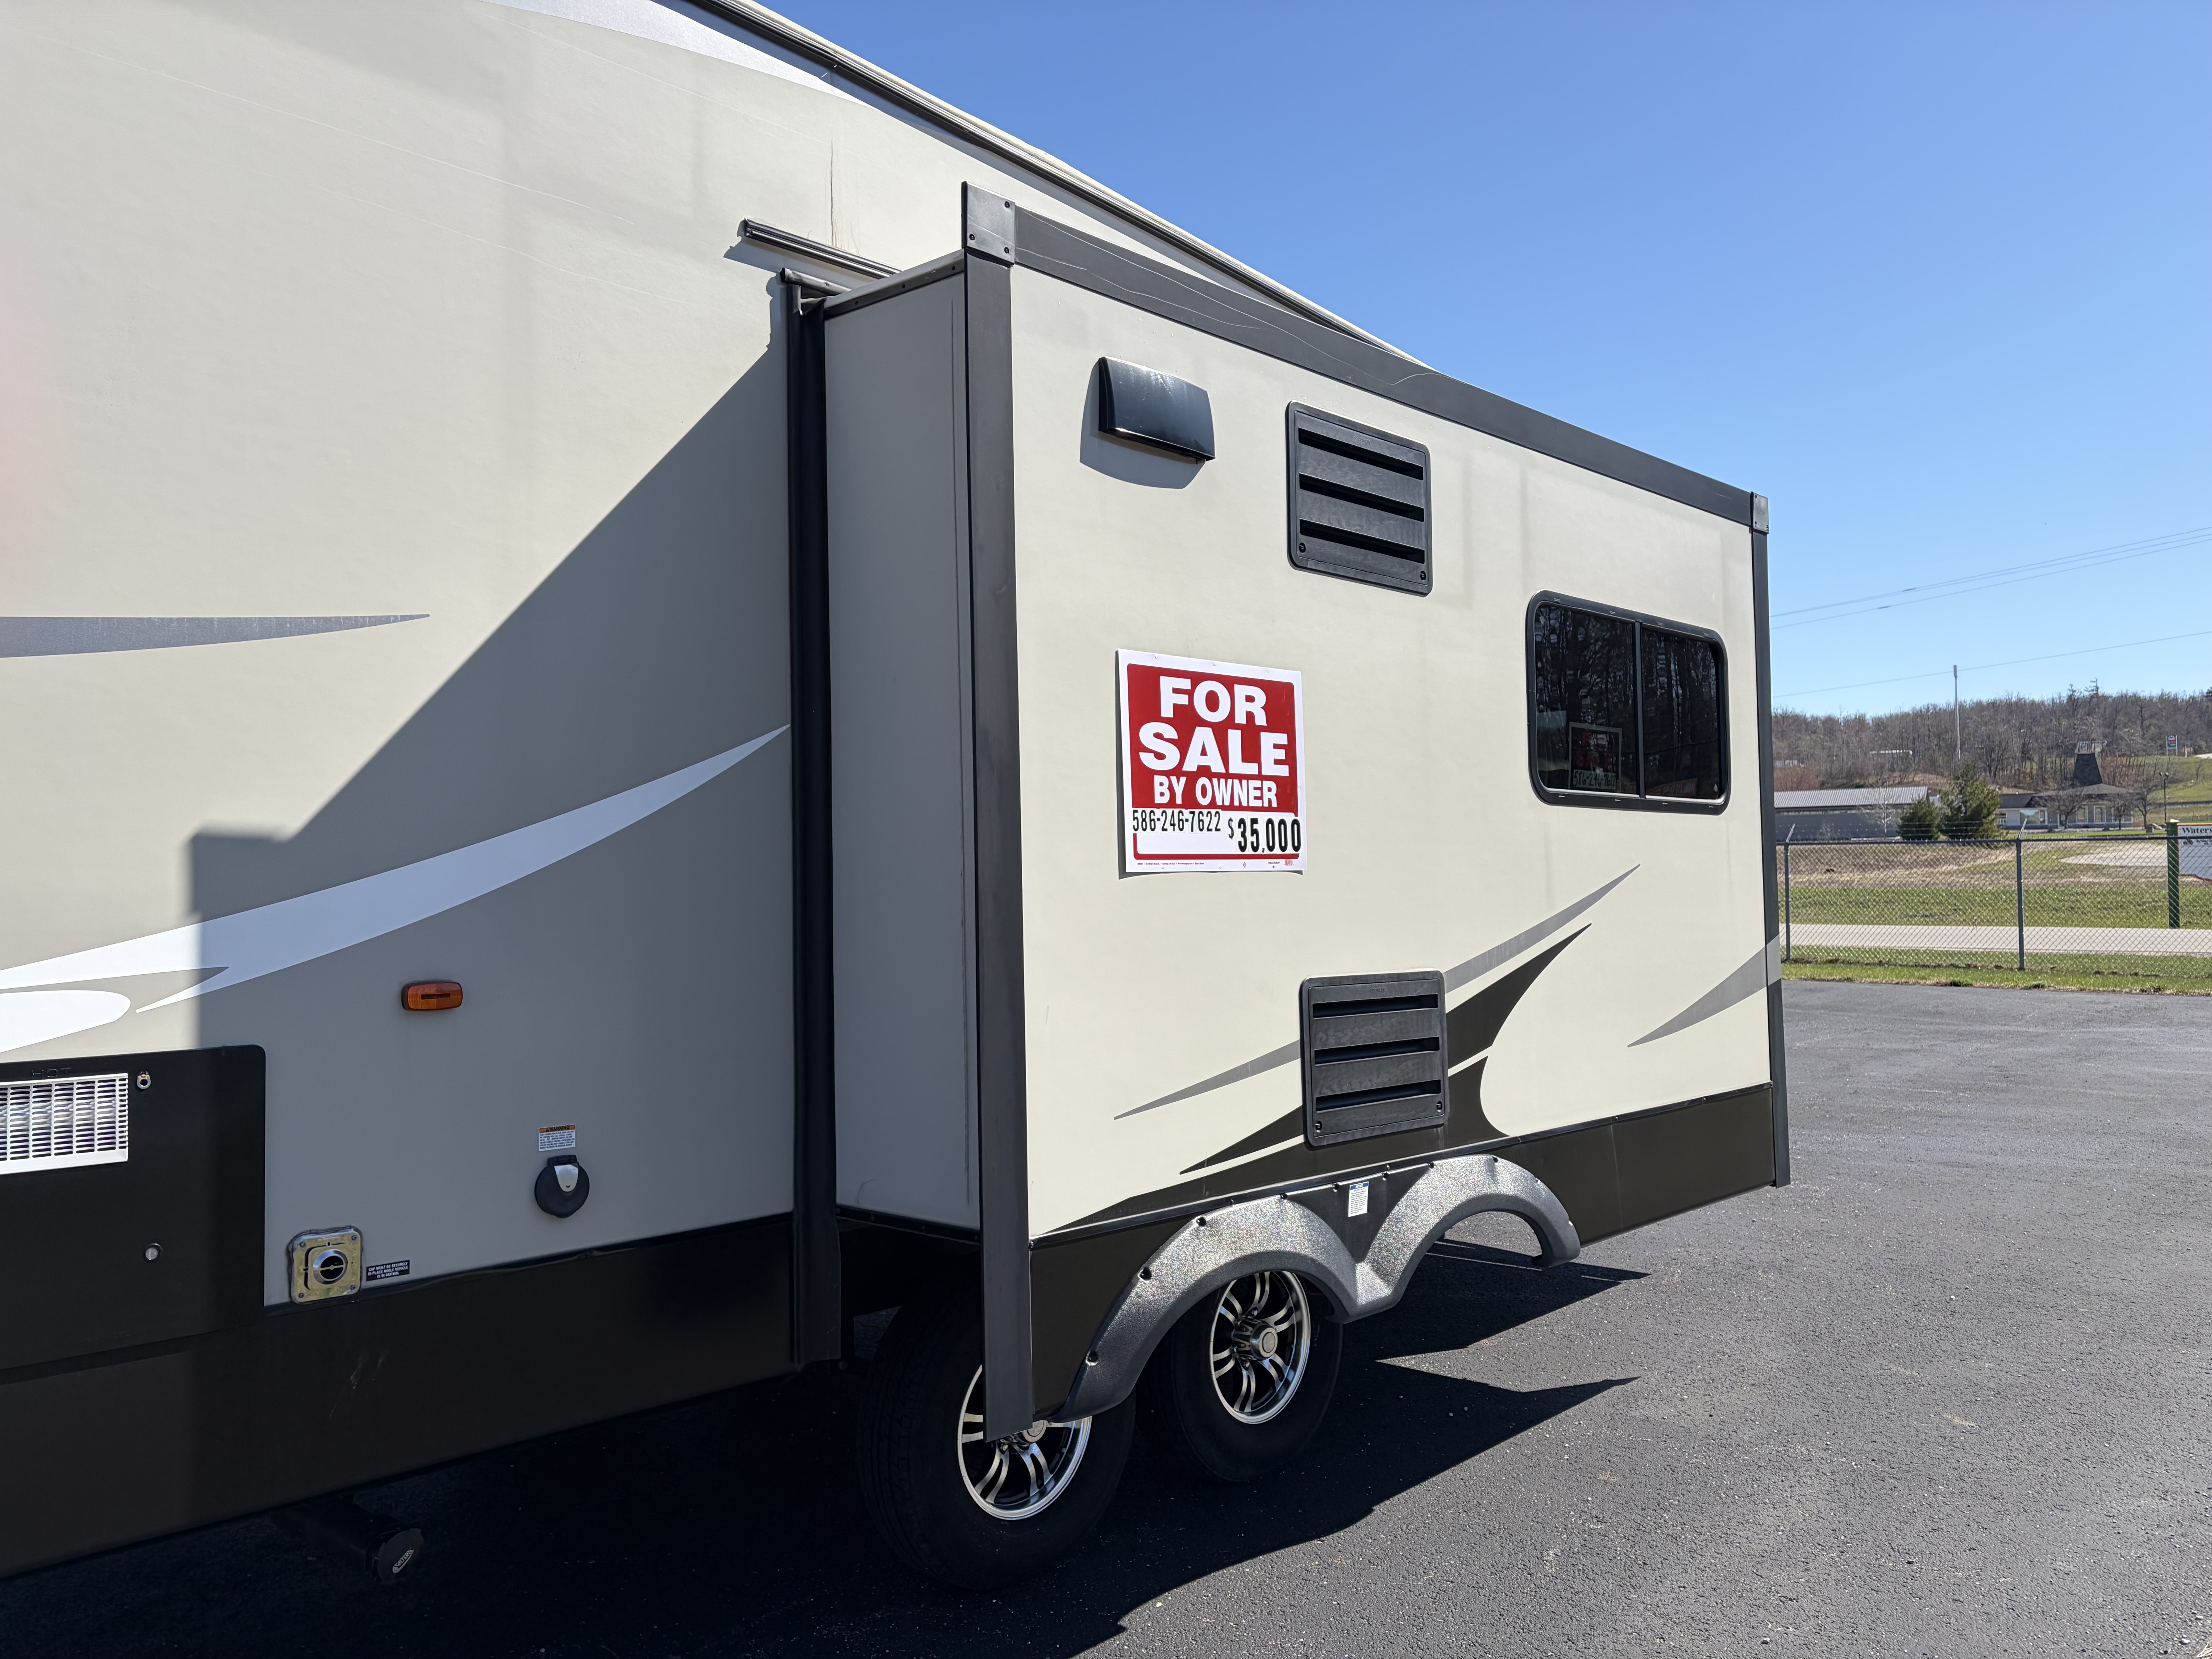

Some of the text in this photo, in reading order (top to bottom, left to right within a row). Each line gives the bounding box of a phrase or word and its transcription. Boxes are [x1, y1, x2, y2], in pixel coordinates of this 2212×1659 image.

[1160, 675, 1267, 726] FOR
[1139, 722, 1289, 776] SALE
[1154, 775, 1278, 807] BY OWNER
[1132, 809, 1302, 854] 586-246-7622 $35,000
[31, 1067, 71, 1079] HOT
